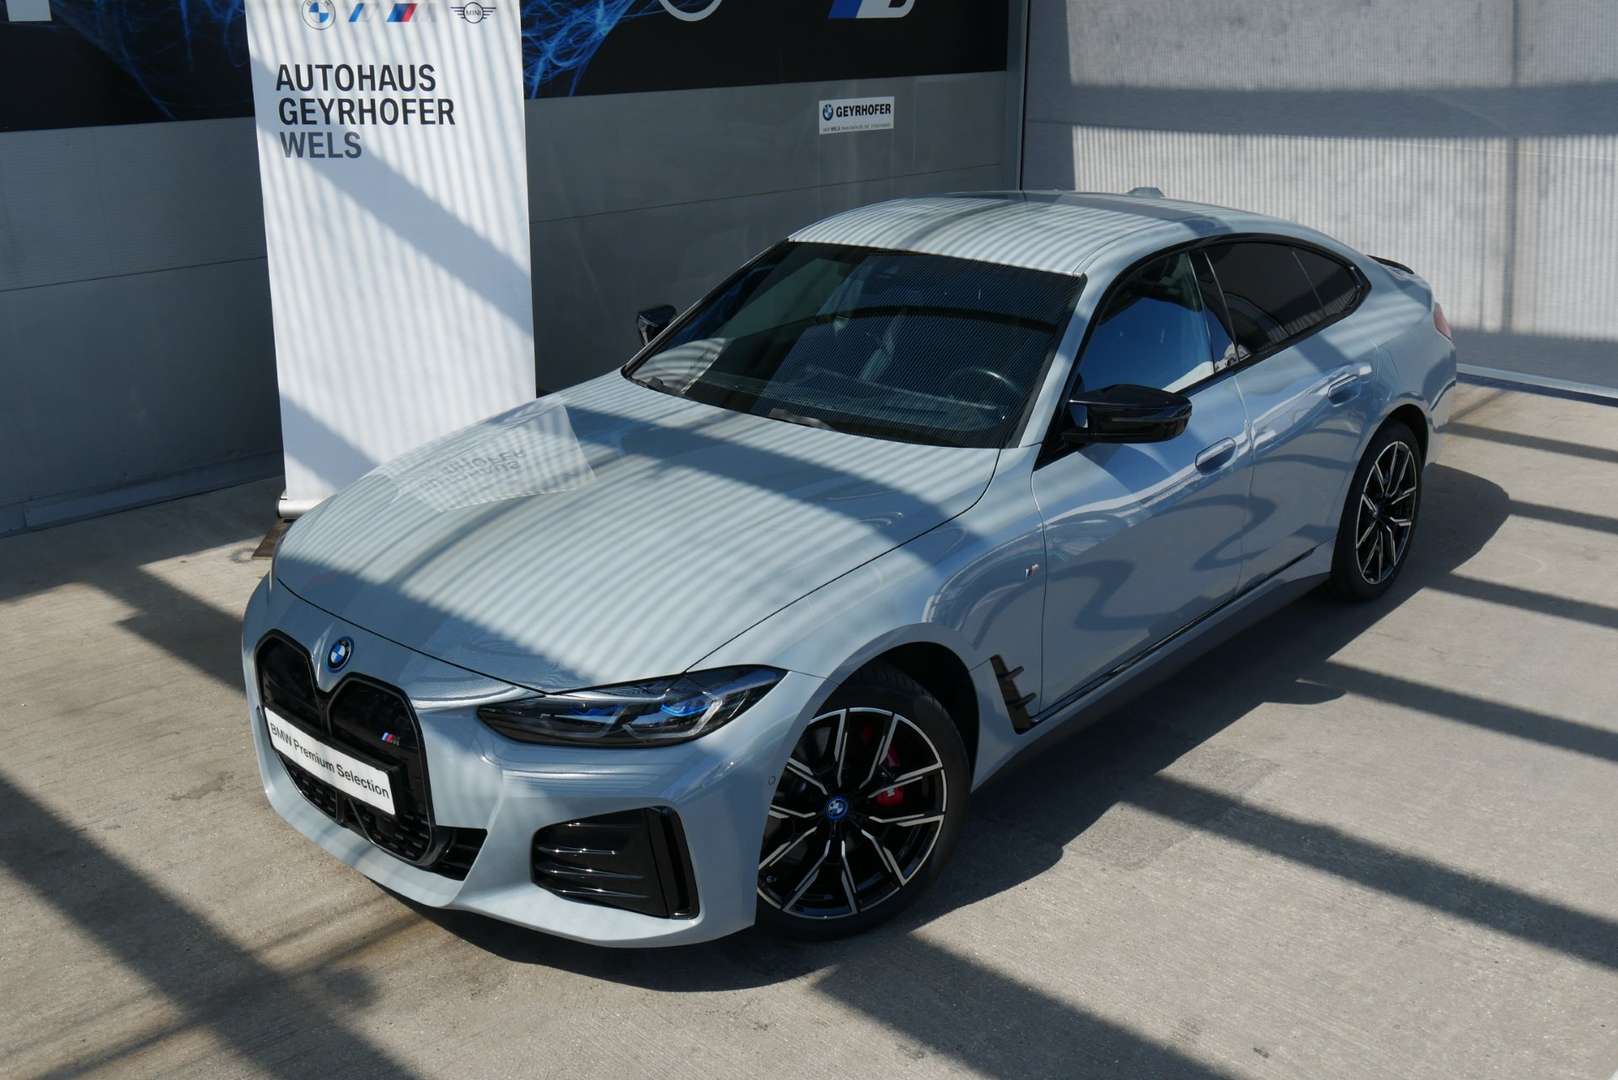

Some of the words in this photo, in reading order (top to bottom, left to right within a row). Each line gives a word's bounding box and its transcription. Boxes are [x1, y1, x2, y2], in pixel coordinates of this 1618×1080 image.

[276, 64, 436, 92] AUTOHAUS
[279, 97, 455, 125] GEYRHOFER
[836, 103, 891, 117] GEYRHOFER
[280, 132, 362, 159] WELS
[270, 722, 292, 746] BMW
[293, 739, 335, 773] Premium
[336, 763, 389, 799] Selection
